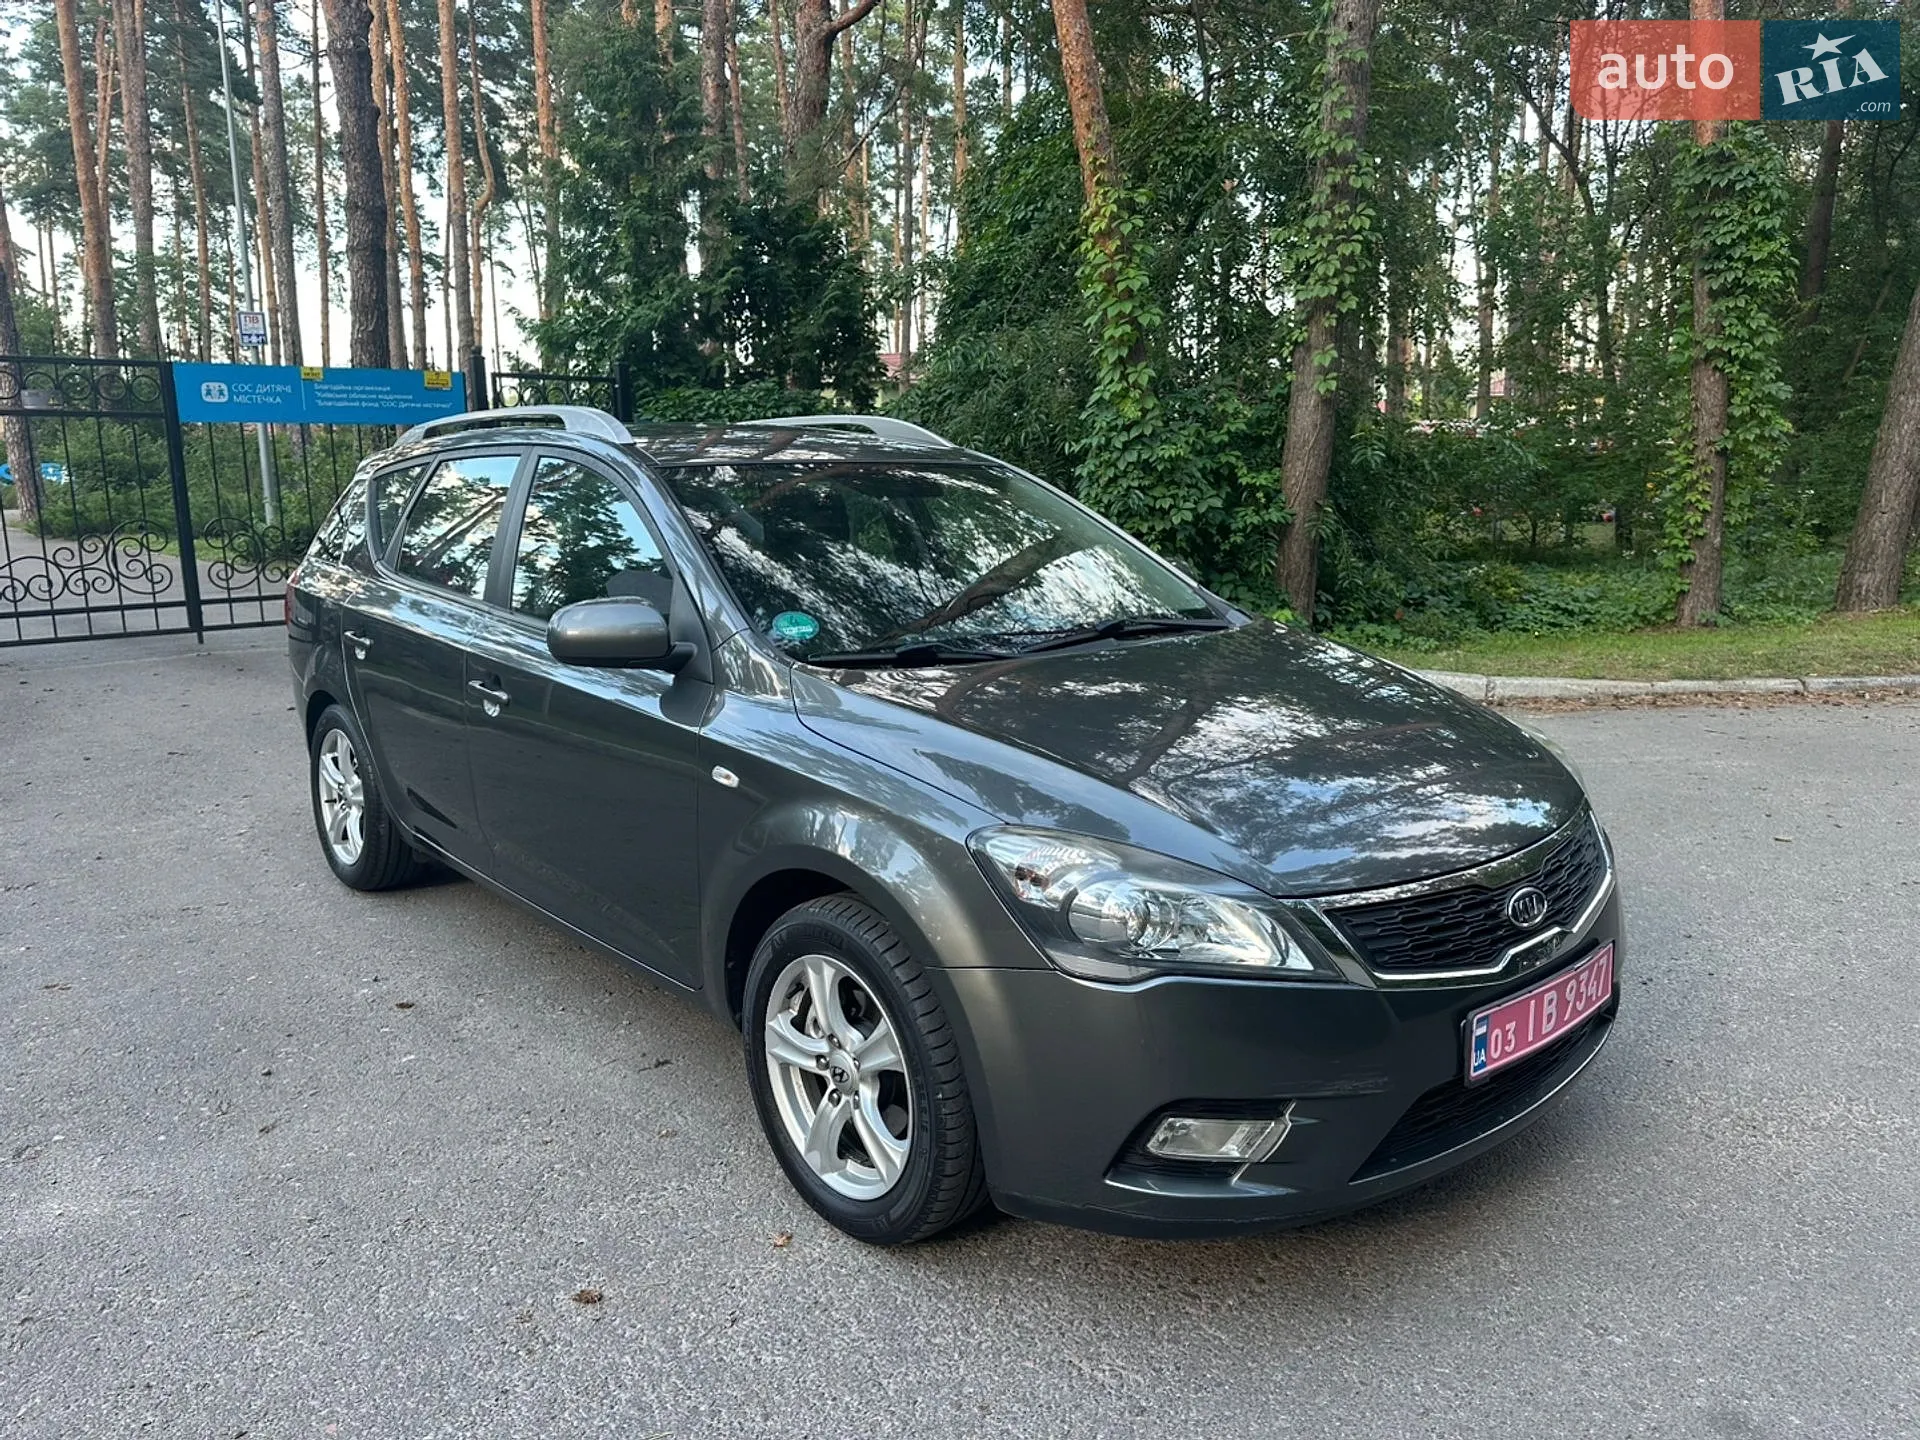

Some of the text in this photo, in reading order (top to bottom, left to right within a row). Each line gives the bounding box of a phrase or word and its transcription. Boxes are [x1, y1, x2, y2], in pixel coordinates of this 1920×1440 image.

[231, 383, 253, 393] СОС
[233, 394, 282, 405] МІСТЕЧКА
[1490, 1021, 1517, 1060] 03
[1563, 956, 1608, 1022] 9347
[1473, 1050, 1487, 1066] UA
